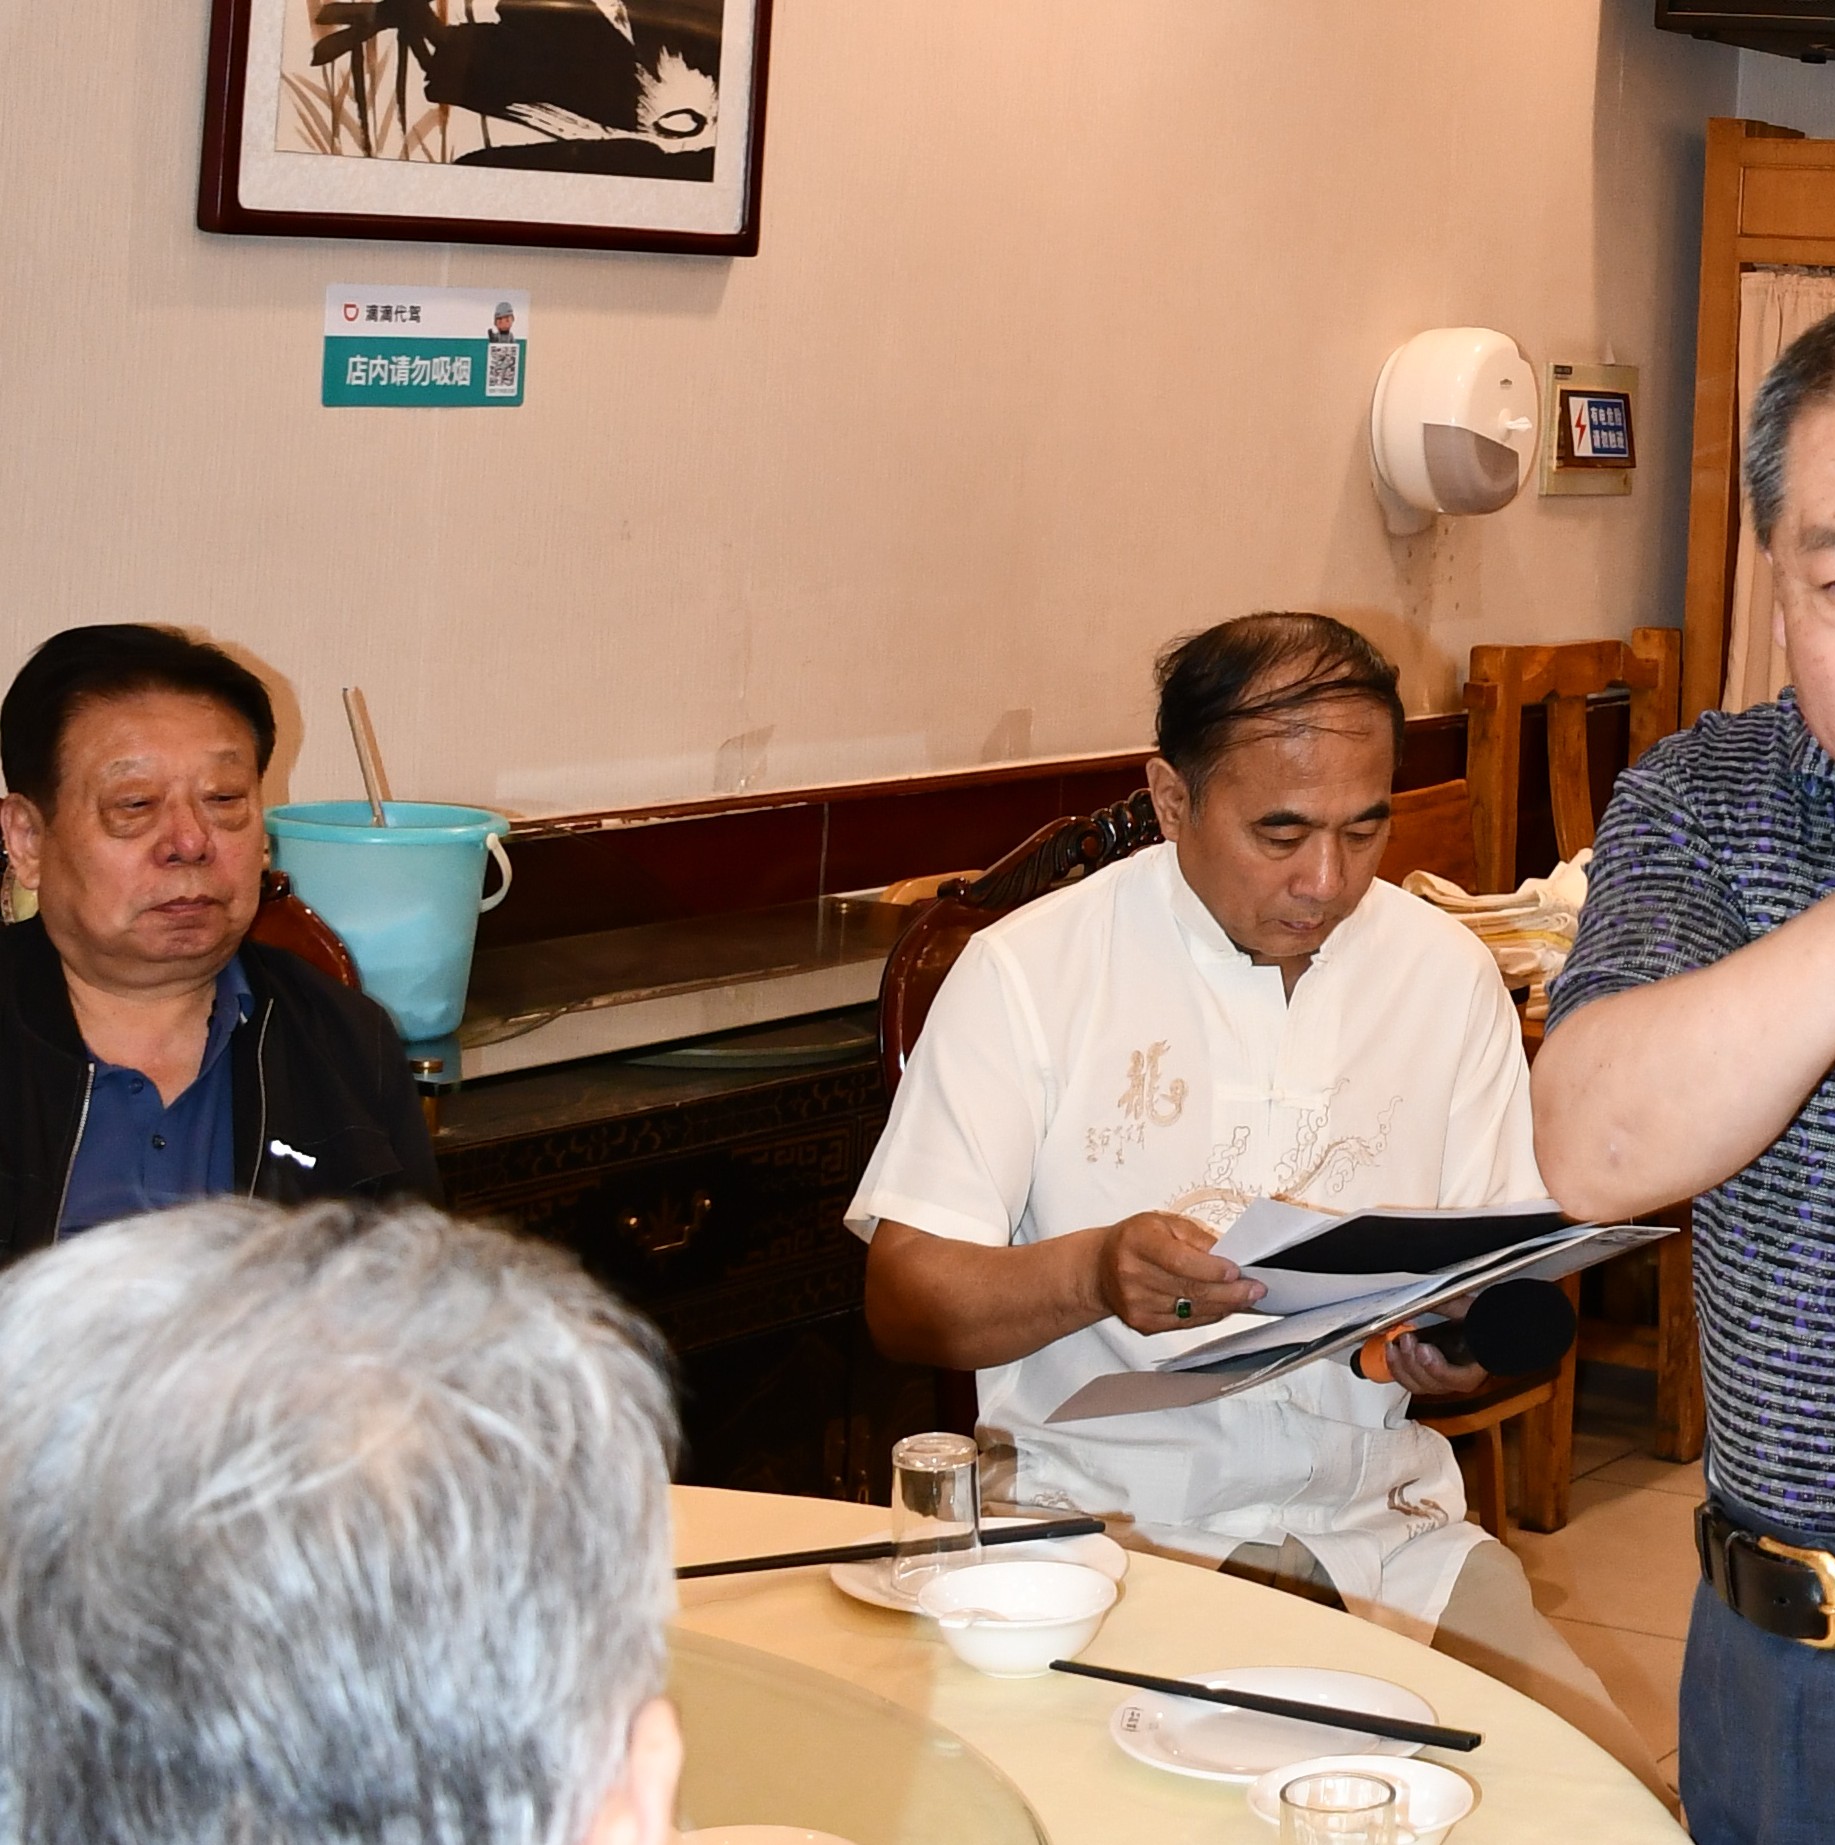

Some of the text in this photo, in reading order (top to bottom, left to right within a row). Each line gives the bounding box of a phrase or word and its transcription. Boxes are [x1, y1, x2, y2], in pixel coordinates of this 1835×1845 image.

[365, 304, 421, 323] 滴滴代驾
[346, 355, 472, 387] 店内请勿吸烟
